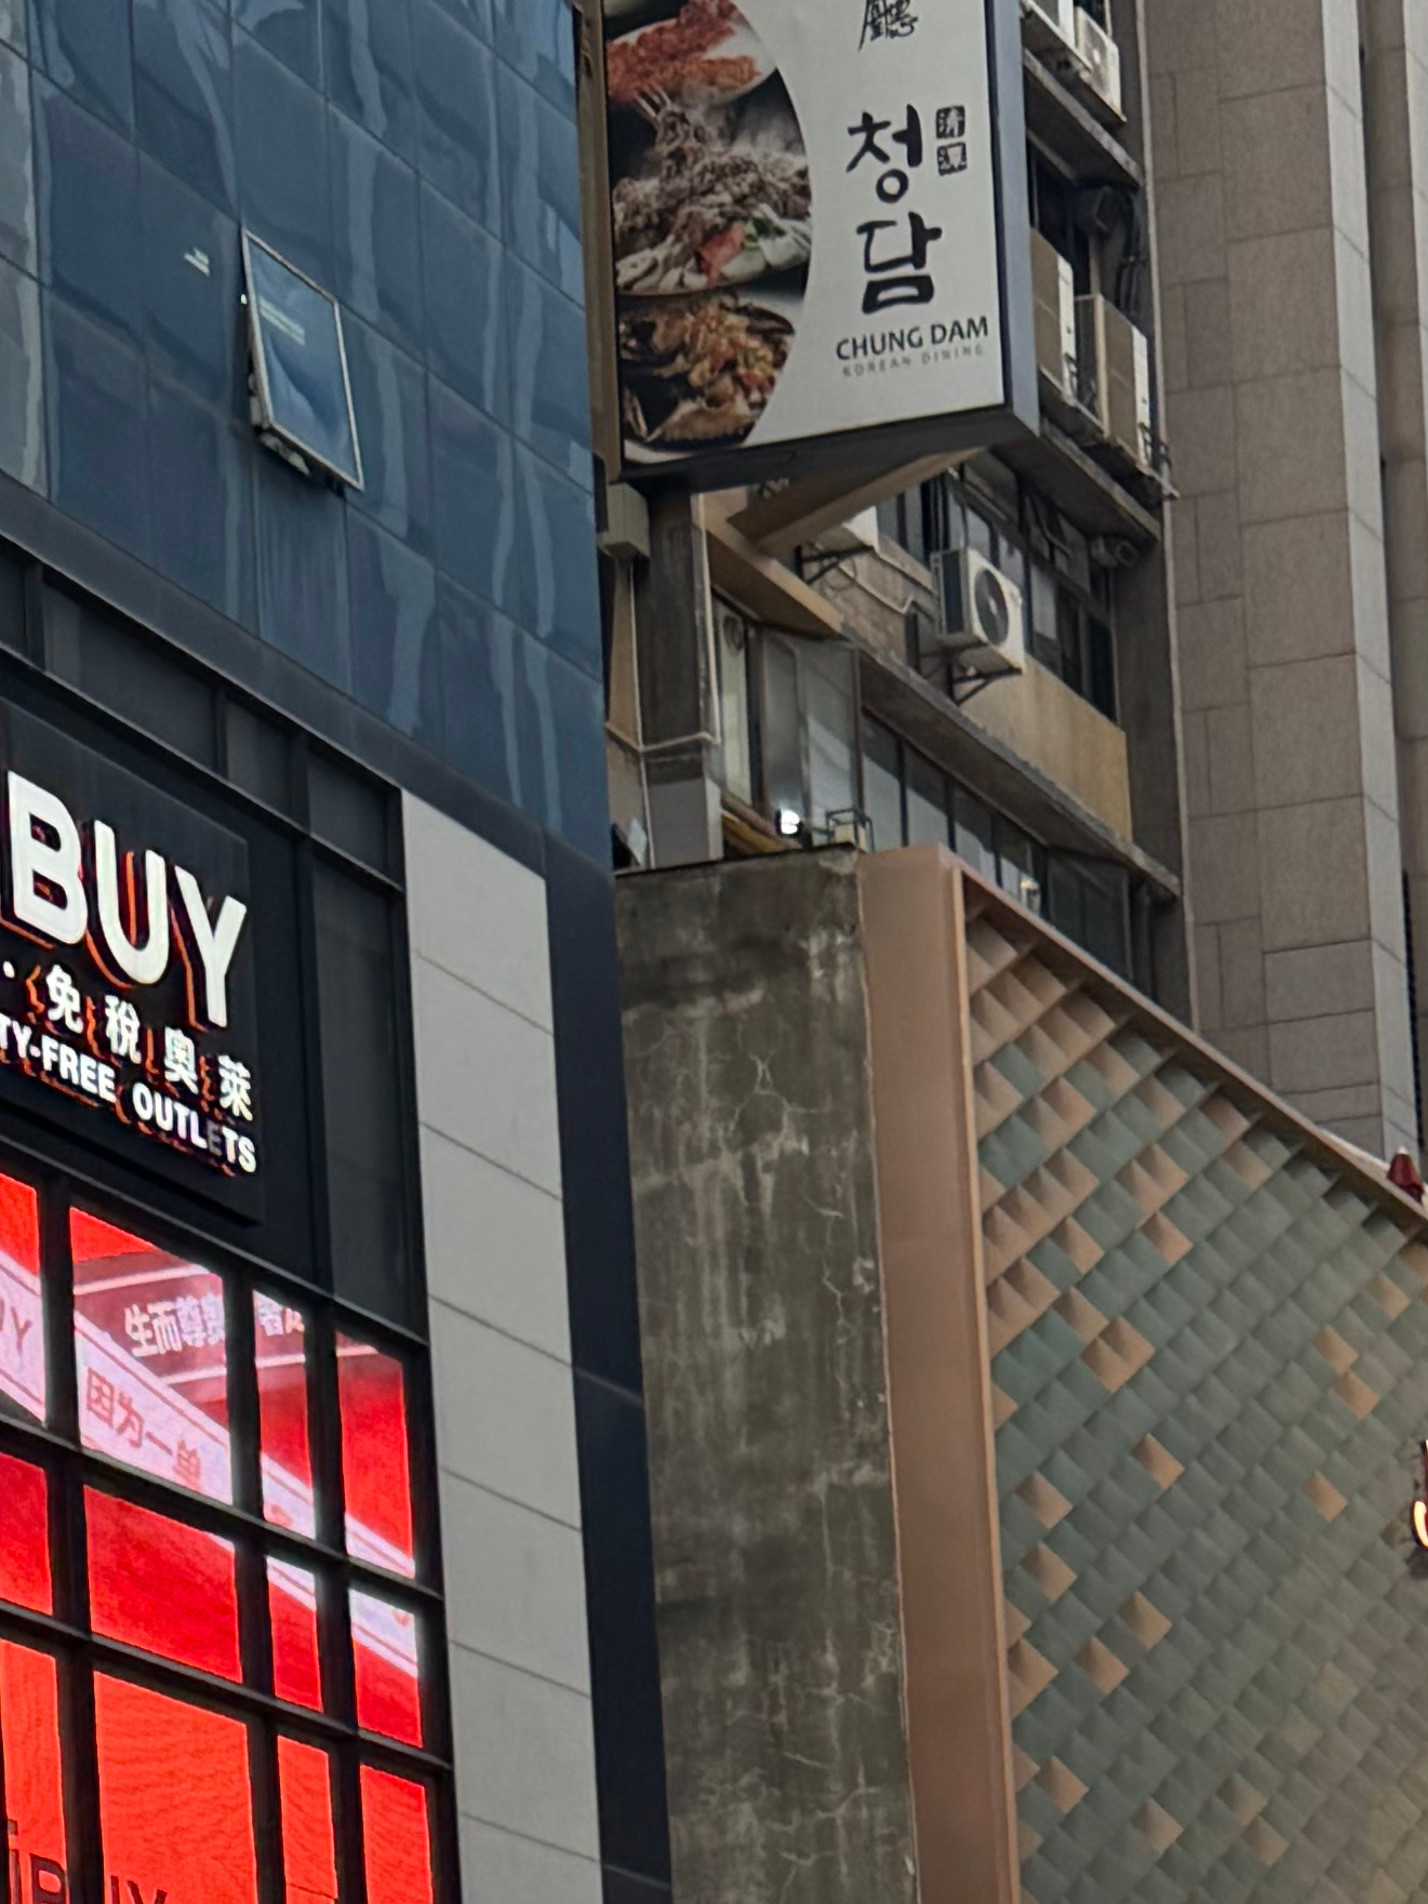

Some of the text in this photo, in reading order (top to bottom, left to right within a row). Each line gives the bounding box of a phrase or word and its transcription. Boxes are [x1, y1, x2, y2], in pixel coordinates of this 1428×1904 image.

[845, 103, 943, 315] 청담
[835, 315, 989, 361] CHUNG DAM
[921, 344, 984, 366] DINING
[8, 770, 247, 1027] BUY
[132, 1082, 256, 1173] OUTLETS
